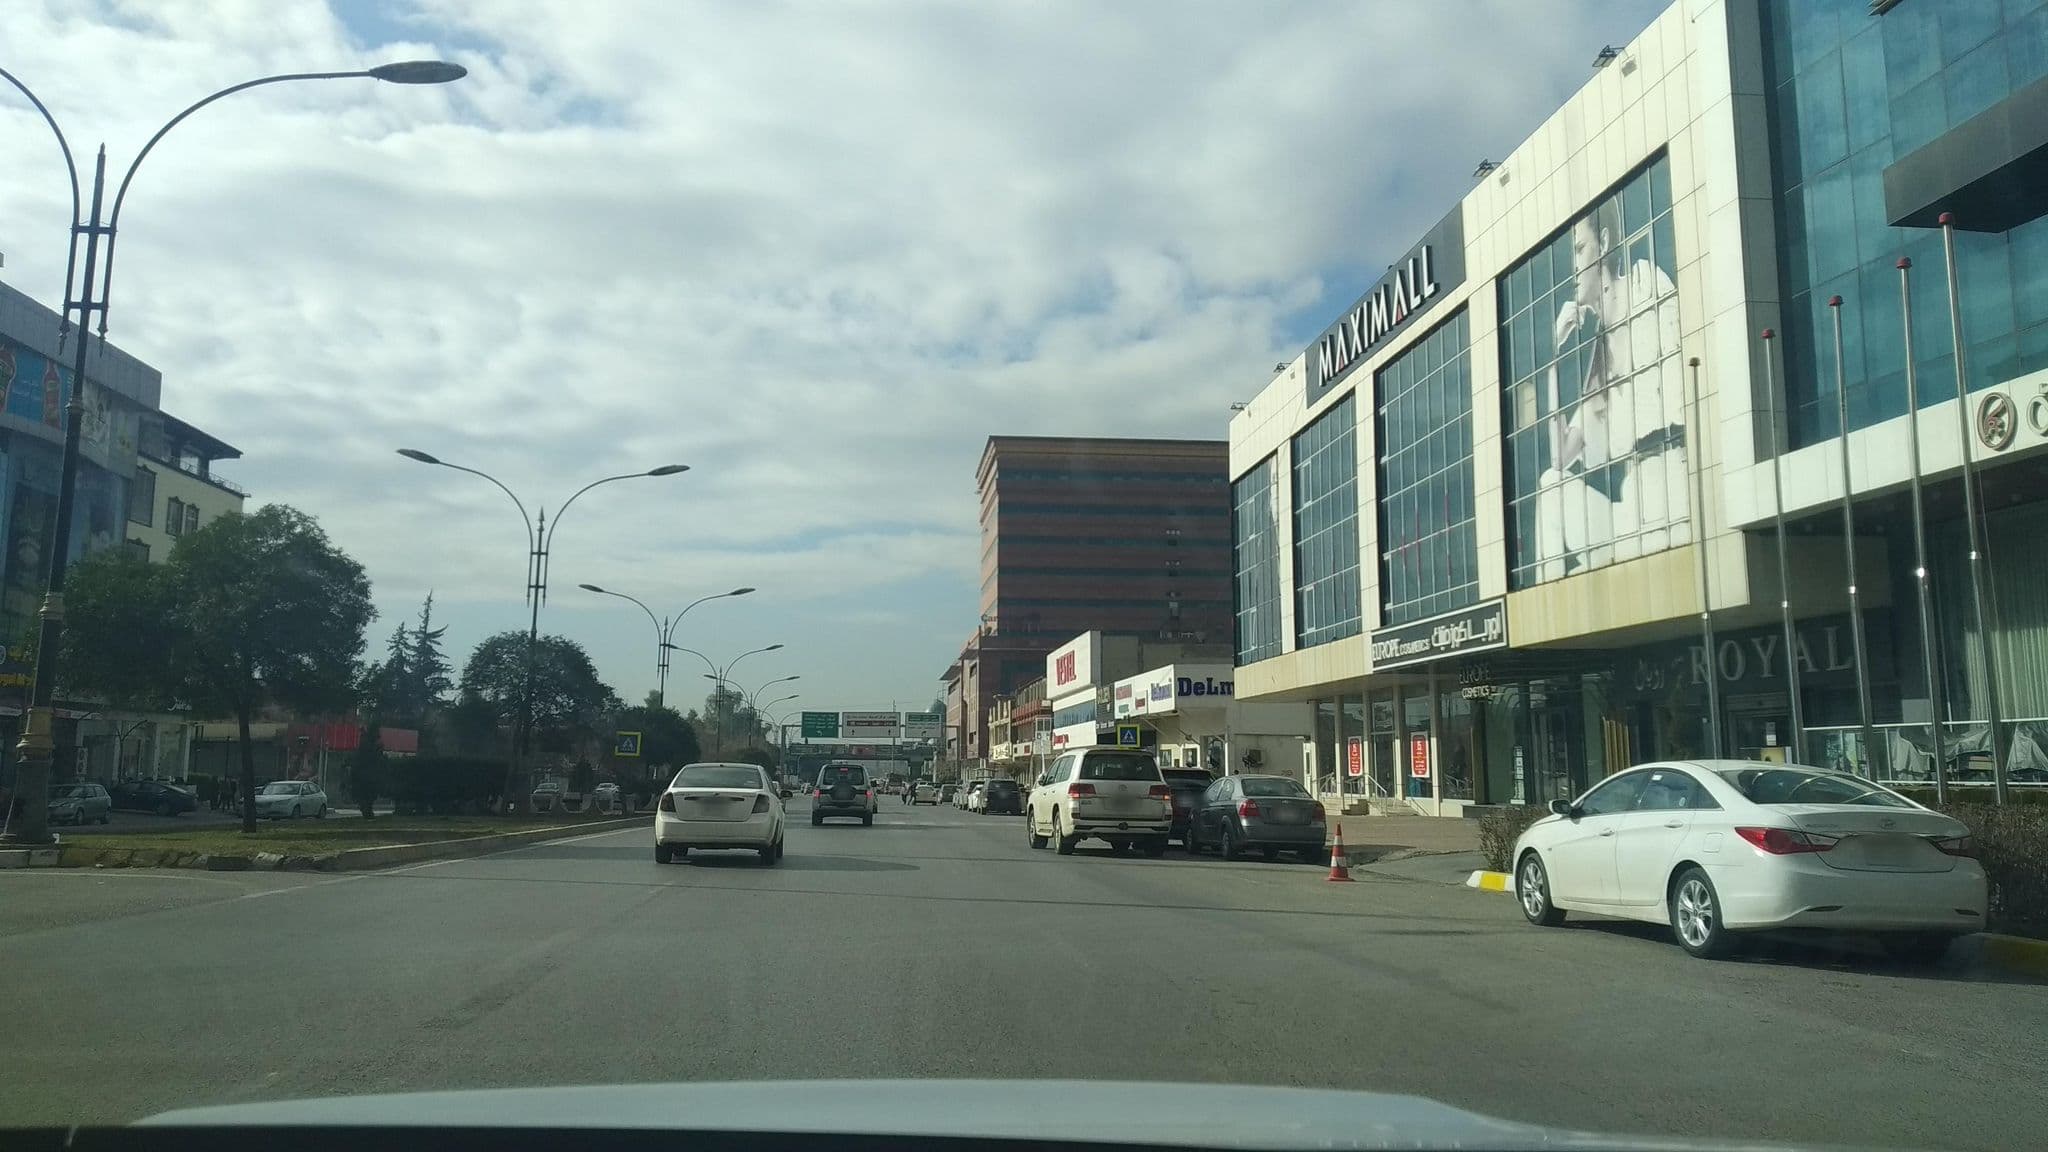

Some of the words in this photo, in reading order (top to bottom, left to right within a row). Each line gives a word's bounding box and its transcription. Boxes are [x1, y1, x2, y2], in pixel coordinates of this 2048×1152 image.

[1319, 245, 1436, 387] MAXIMALL
[1372, 638, 1400, 661] EUROPE
[1688, 626, 1854, 685] ROYAL
